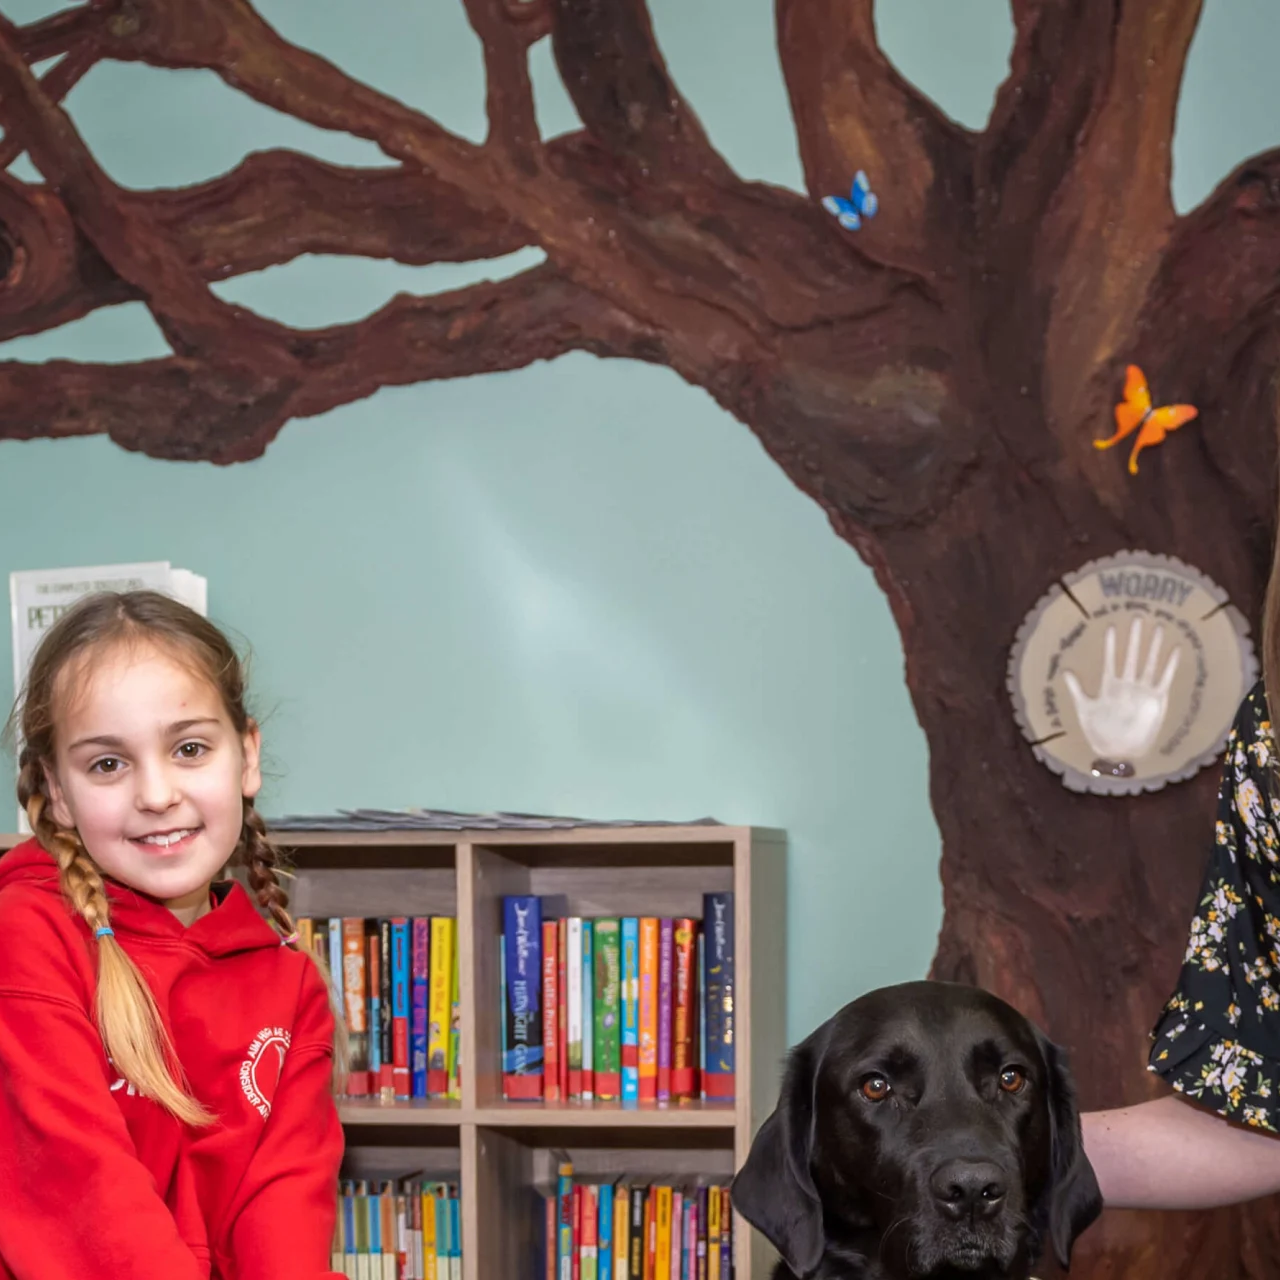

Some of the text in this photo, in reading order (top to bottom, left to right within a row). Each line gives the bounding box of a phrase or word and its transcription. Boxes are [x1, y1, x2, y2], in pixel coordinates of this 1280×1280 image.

[1098, 572, 1195, 606] WORRY
[247, 1039, 262, 1059] AIM
[239, 1060, 261, 1107] CONSIDER
